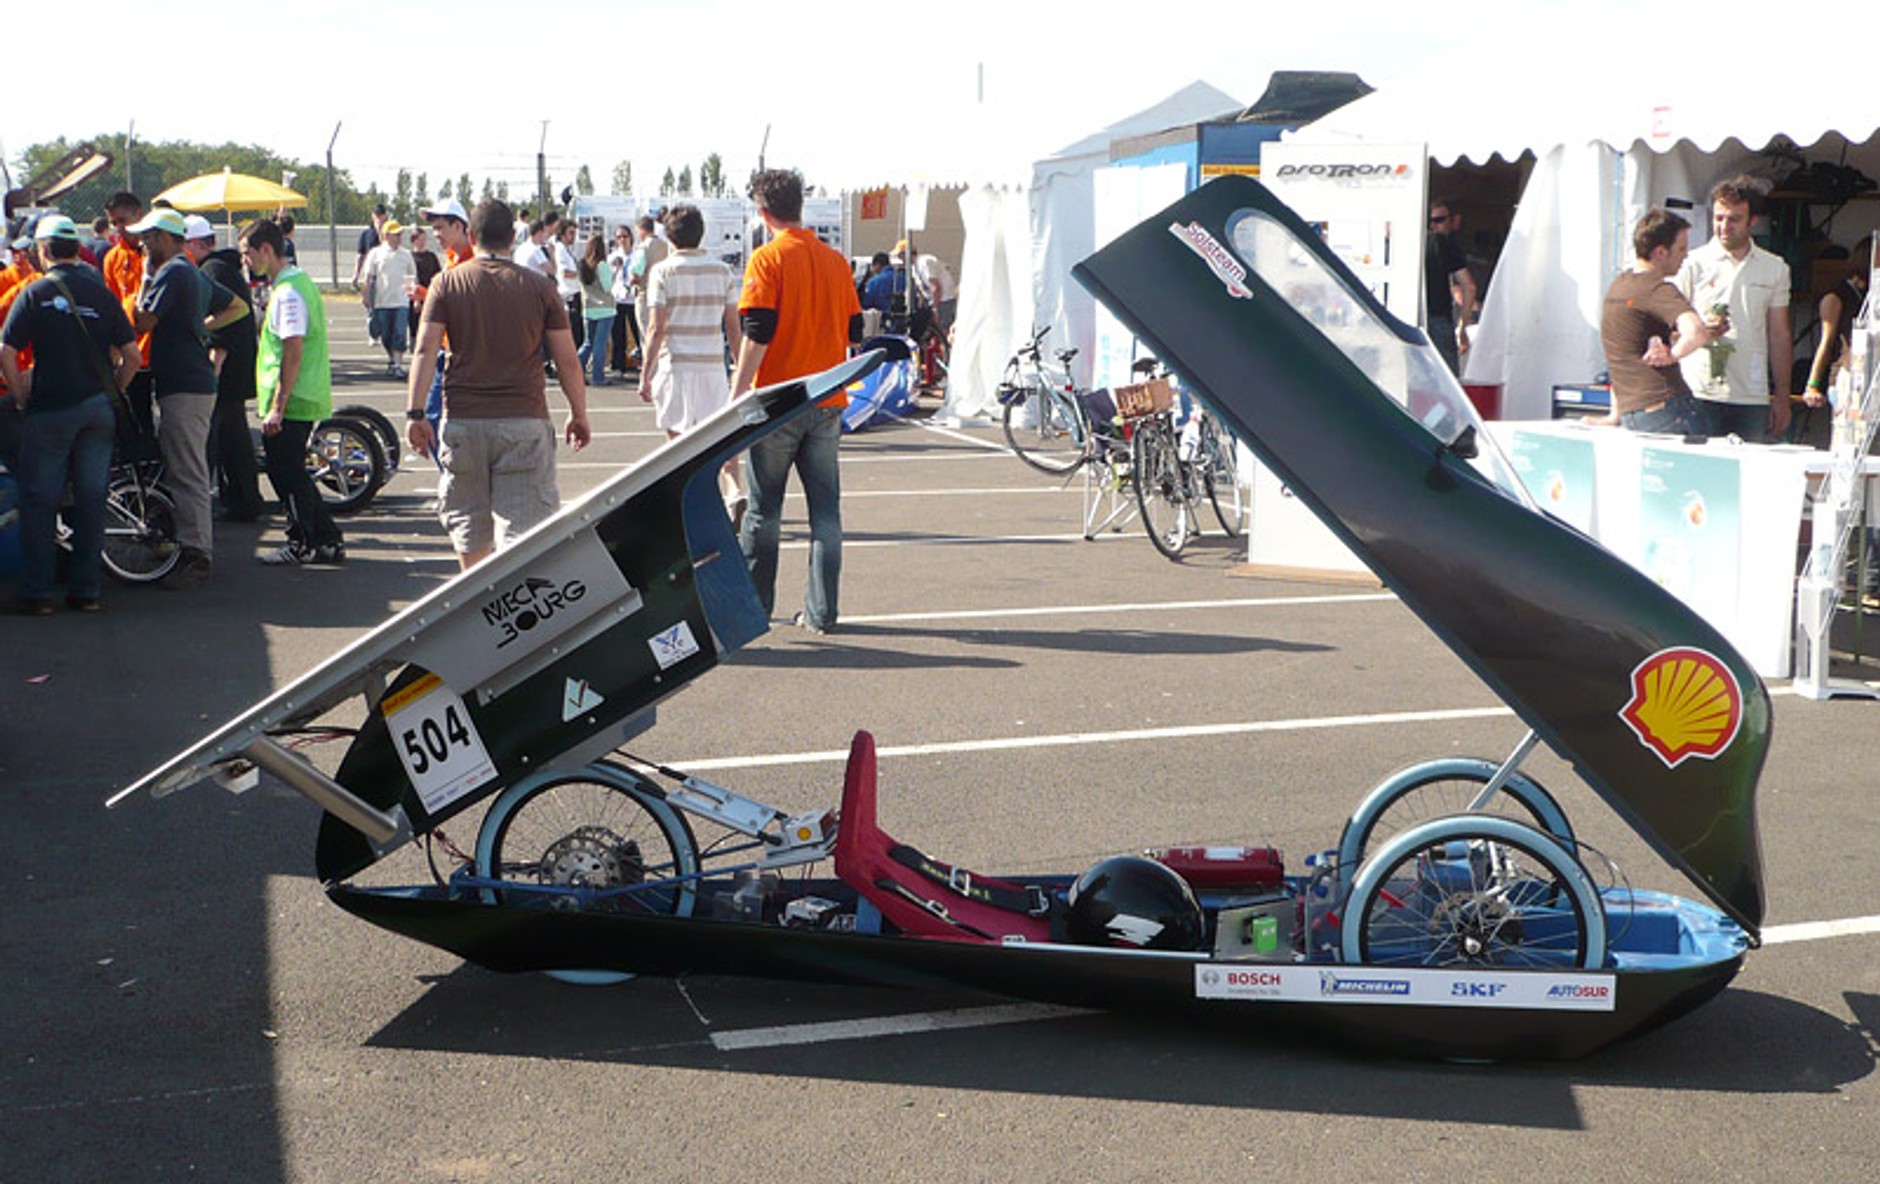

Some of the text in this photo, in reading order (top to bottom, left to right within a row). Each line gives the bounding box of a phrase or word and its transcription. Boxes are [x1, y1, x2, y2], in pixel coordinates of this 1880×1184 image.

[482, 578, 555, 626] MECA
[403, 704, 471, 775] 504
[1227, 972, 1281, 986] BOSCH
[1336, 980, 1408, 994] MICHELIN
[1451, 982, 1508, 997] SKF
[1547, 984, 1610, 998] AUTOSUR
